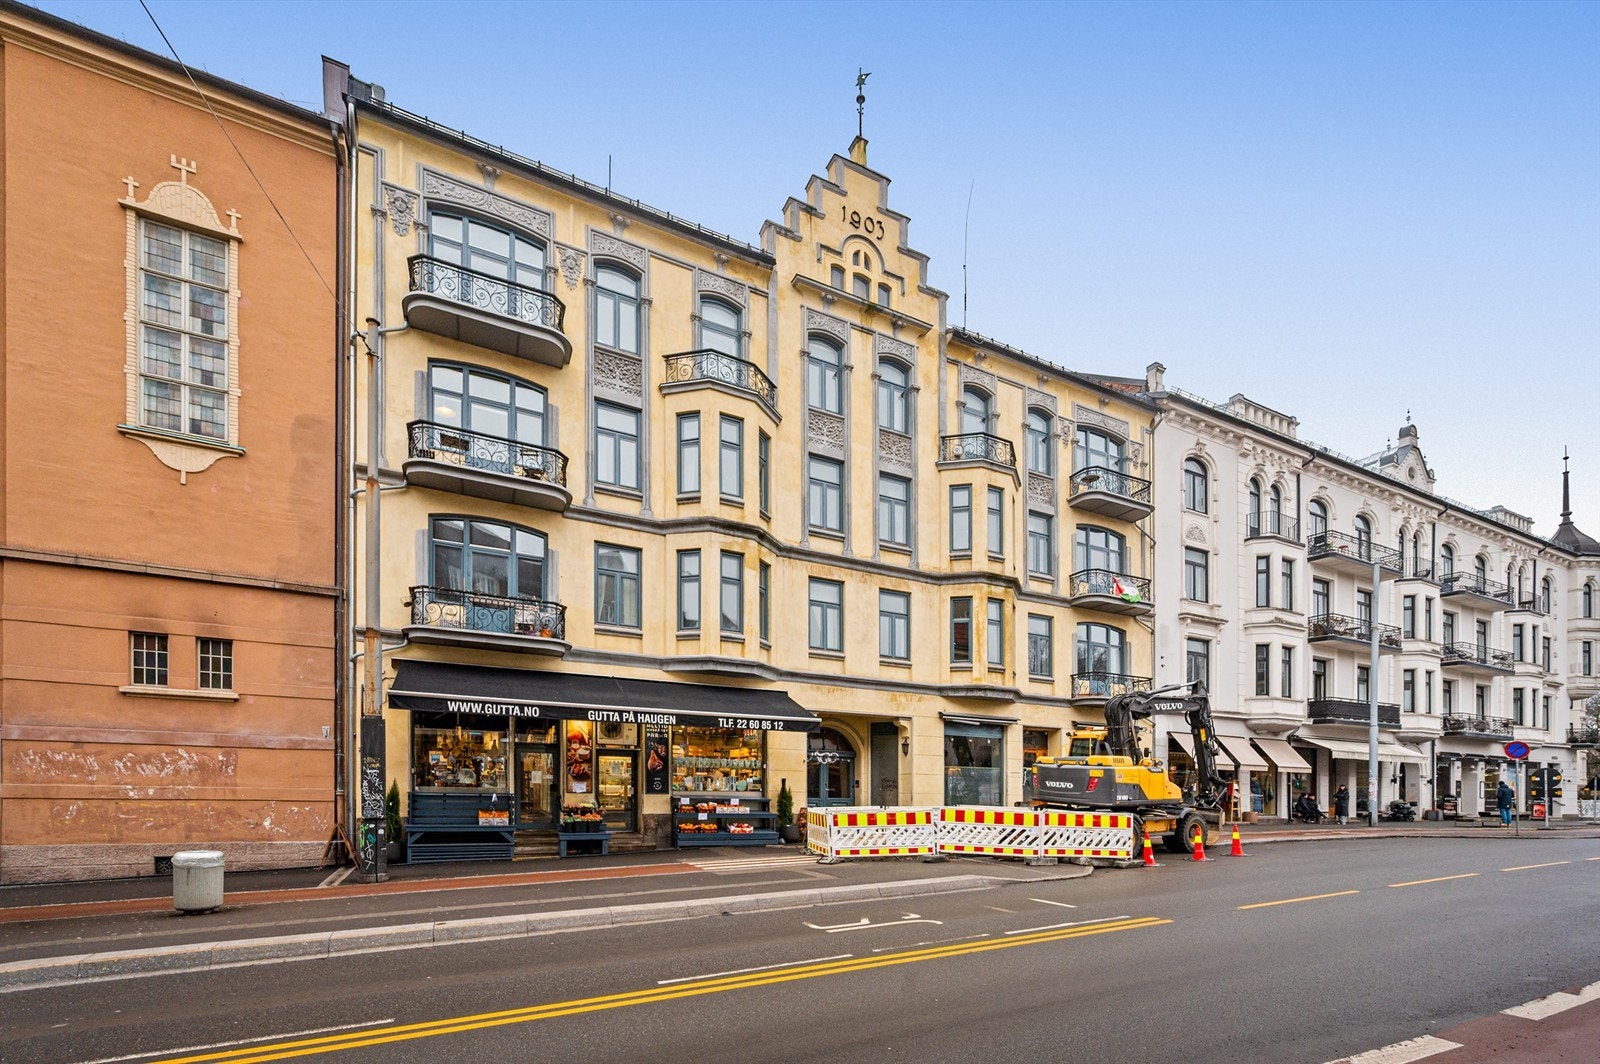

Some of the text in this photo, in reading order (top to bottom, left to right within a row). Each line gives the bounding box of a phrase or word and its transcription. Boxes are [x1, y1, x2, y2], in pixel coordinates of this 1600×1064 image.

[842, 205, 885, 240] 1903
[447, 700, 540, 717] WWW.GUTTA.NO
[1154, 702, 1183, 711] VOLVO
[587, 710, 676, 724] GUTTA PÅ HAUGEN
[718, 718, 784, 731] TLF. 22 60 85 12
[1045, 780, 1074, 789] VOLVO
